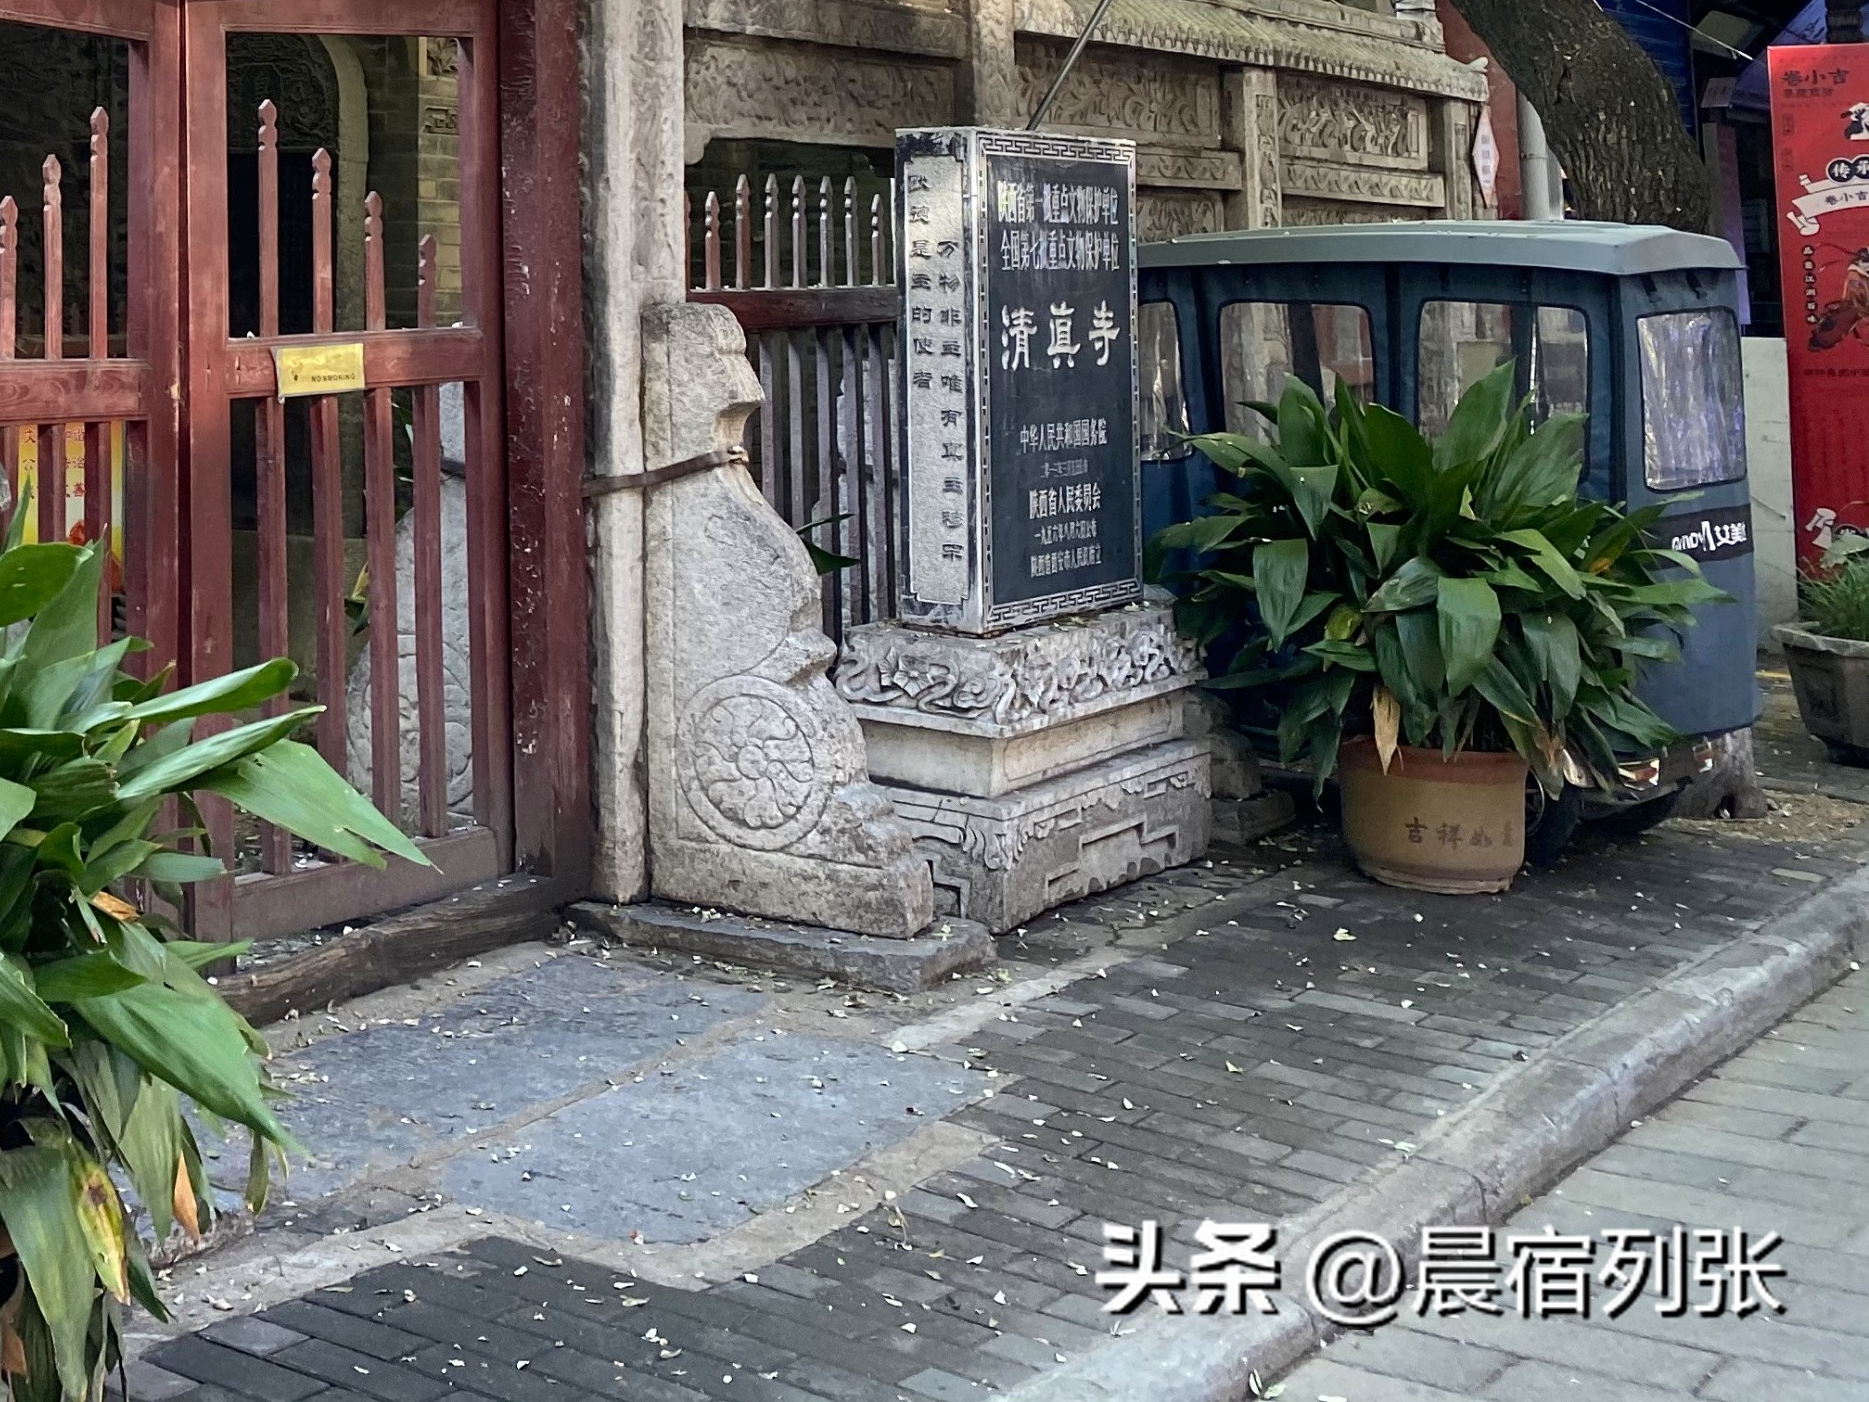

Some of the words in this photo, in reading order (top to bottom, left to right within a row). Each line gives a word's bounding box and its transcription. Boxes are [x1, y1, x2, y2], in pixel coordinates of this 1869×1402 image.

[997, 180, 1119, 226] 陕西省第一批重点文物保护单位
[1000, 228, 1120, 272] 全国第七批重点文物保护单位
[1000, 298, 1121, 372] 清真寺
[1020, 417, 1108, 454] 中华人民共和国国务院
[1029, 482, 1102, 520] 陕西省人民委员会
